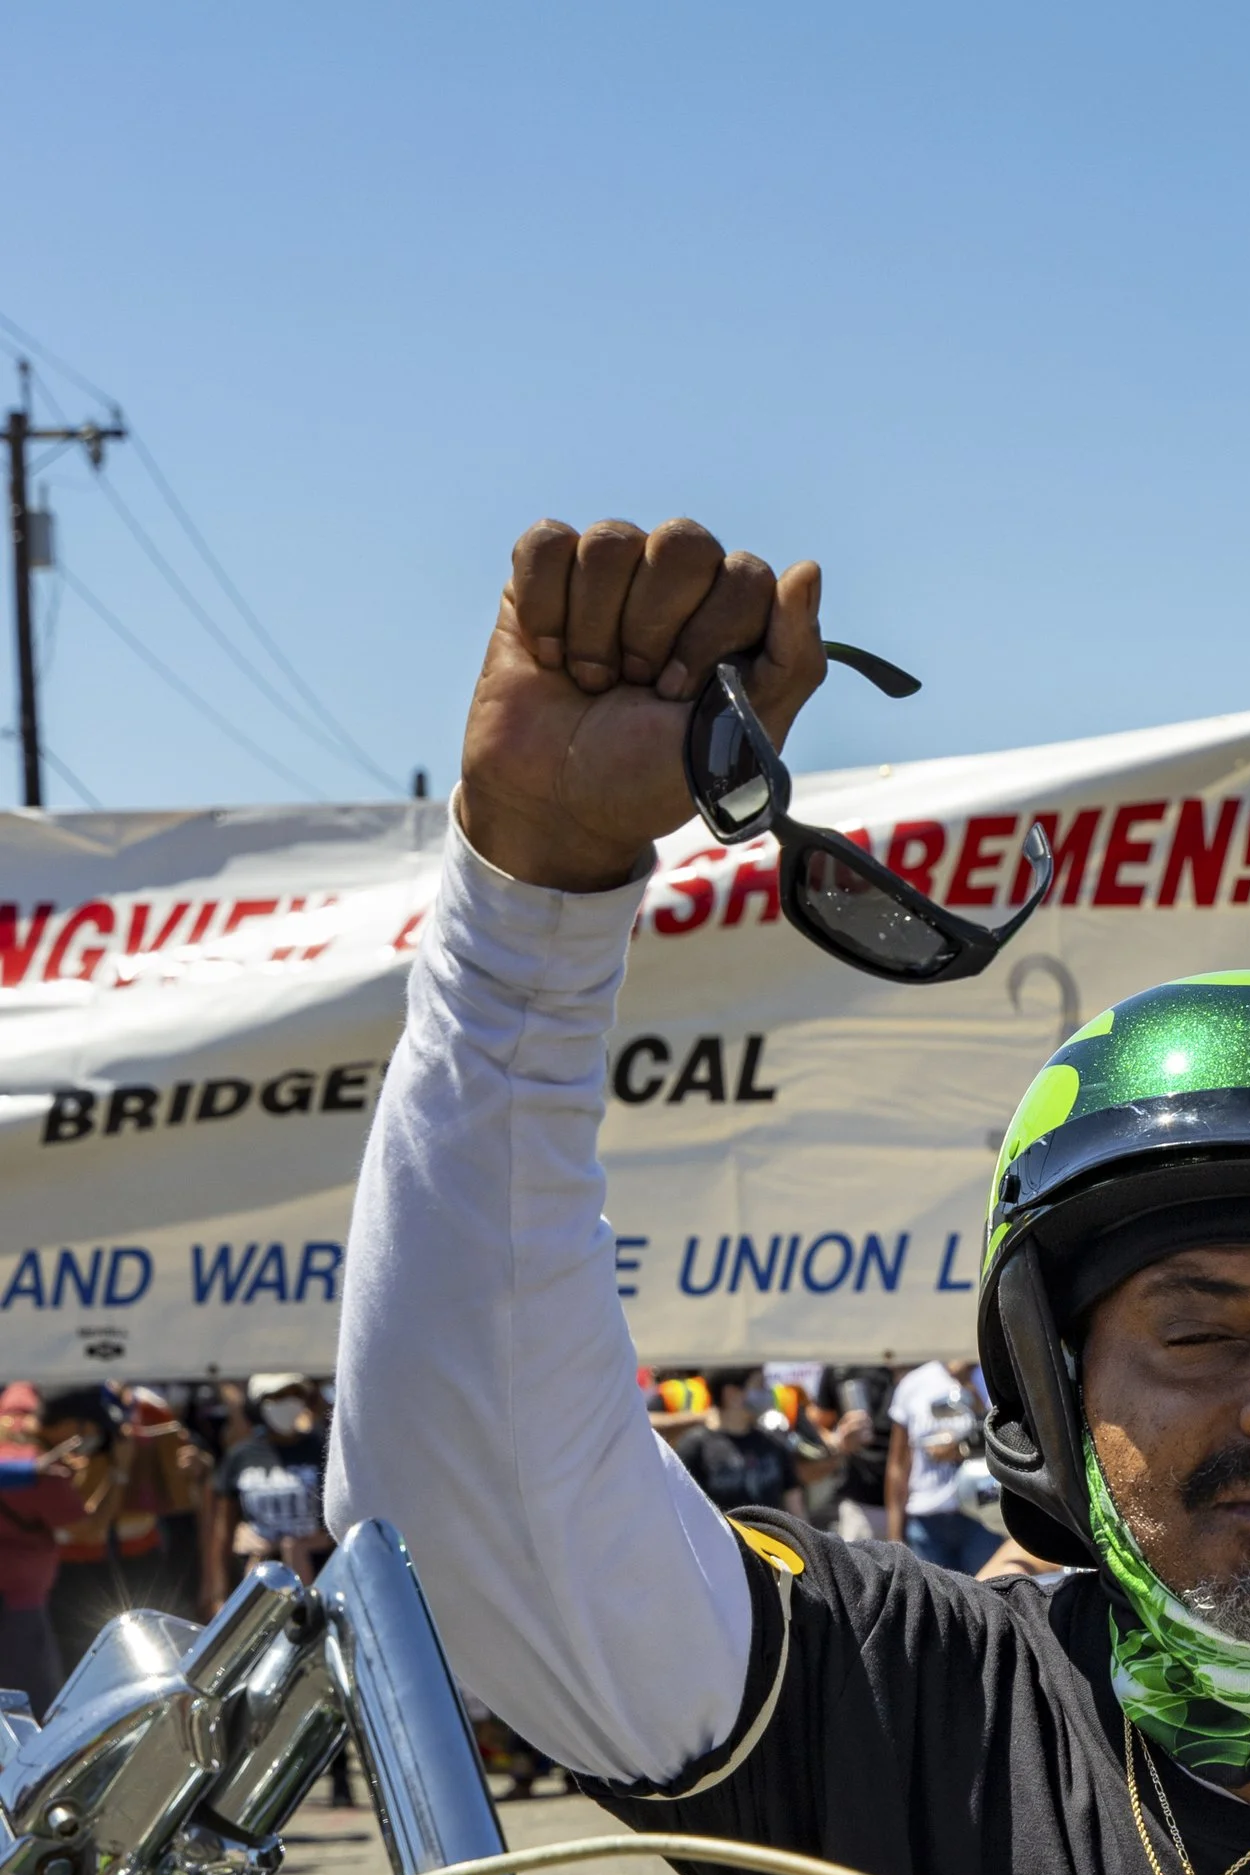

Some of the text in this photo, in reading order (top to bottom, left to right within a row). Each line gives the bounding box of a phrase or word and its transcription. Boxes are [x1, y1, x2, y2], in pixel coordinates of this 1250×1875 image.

[42, 1034, 778, 1146] BRIDGE CAL
[5, 1248, 152, 1309] AND
[680, 1232, 909, 1295] UNION
